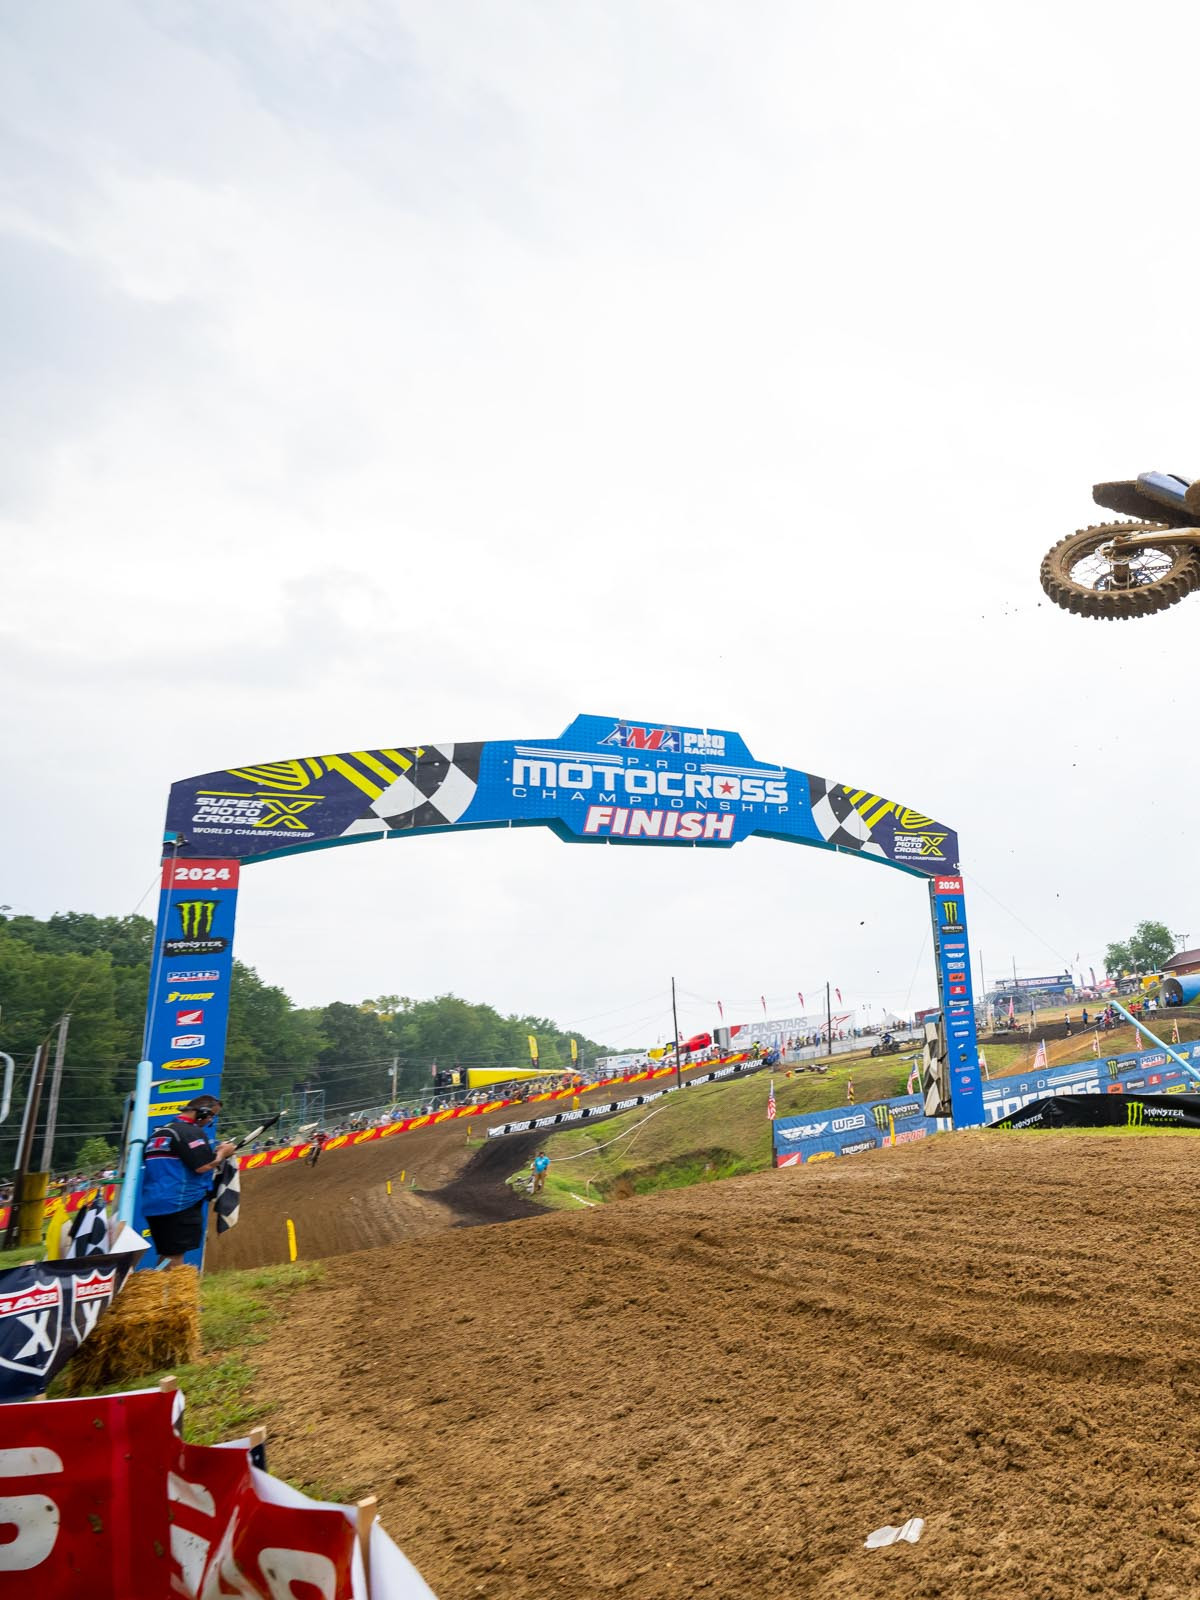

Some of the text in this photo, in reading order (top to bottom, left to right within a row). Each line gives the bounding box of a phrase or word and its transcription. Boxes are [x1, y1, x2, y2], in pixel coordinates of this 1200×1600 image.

[596, 723, 726, 752] AMA PRO
[683, 746, 726, 757] RACING
[627, 757, 697, 772] PRO
[512, 758, 788, 804] MOTOCROSS
[194, 797, 265, 809] SUPER
[512, 787, 788, 815] CHAMPIONSHIP
[198, 805, 261, 817] MOTO
[192, 814, 261, 825] CROSS
[584, 805, 735, 840] FINISH
[192, 827, 315, 838] WORLD CHAMPIONSHIP
[174, 867, 230, 881] 2024
[938, 880, 960, 890] 2024
[166, 940, 223, 949] MONSTER
[740, 1059, 762, 1070] THOR
[714, 1066, 735, 1078] THOR
[690, 1075, 710, 1087] THOR
[616, 1098, 639, 1110] THOR
[888, 1103, 920, 1115] MONSTER
[560, 1110, 583, 1122] THOR
[588, 1104, 611, 1117] THOR
[1143, 1108, 1184, 1117] MONSTER
[509, 1121, 530, 1132] THOR
[535, 1118, 556, 1128] THOR
[833, 1116, 865, 1131] WPS
[13, 1310, 54, 1360] X
